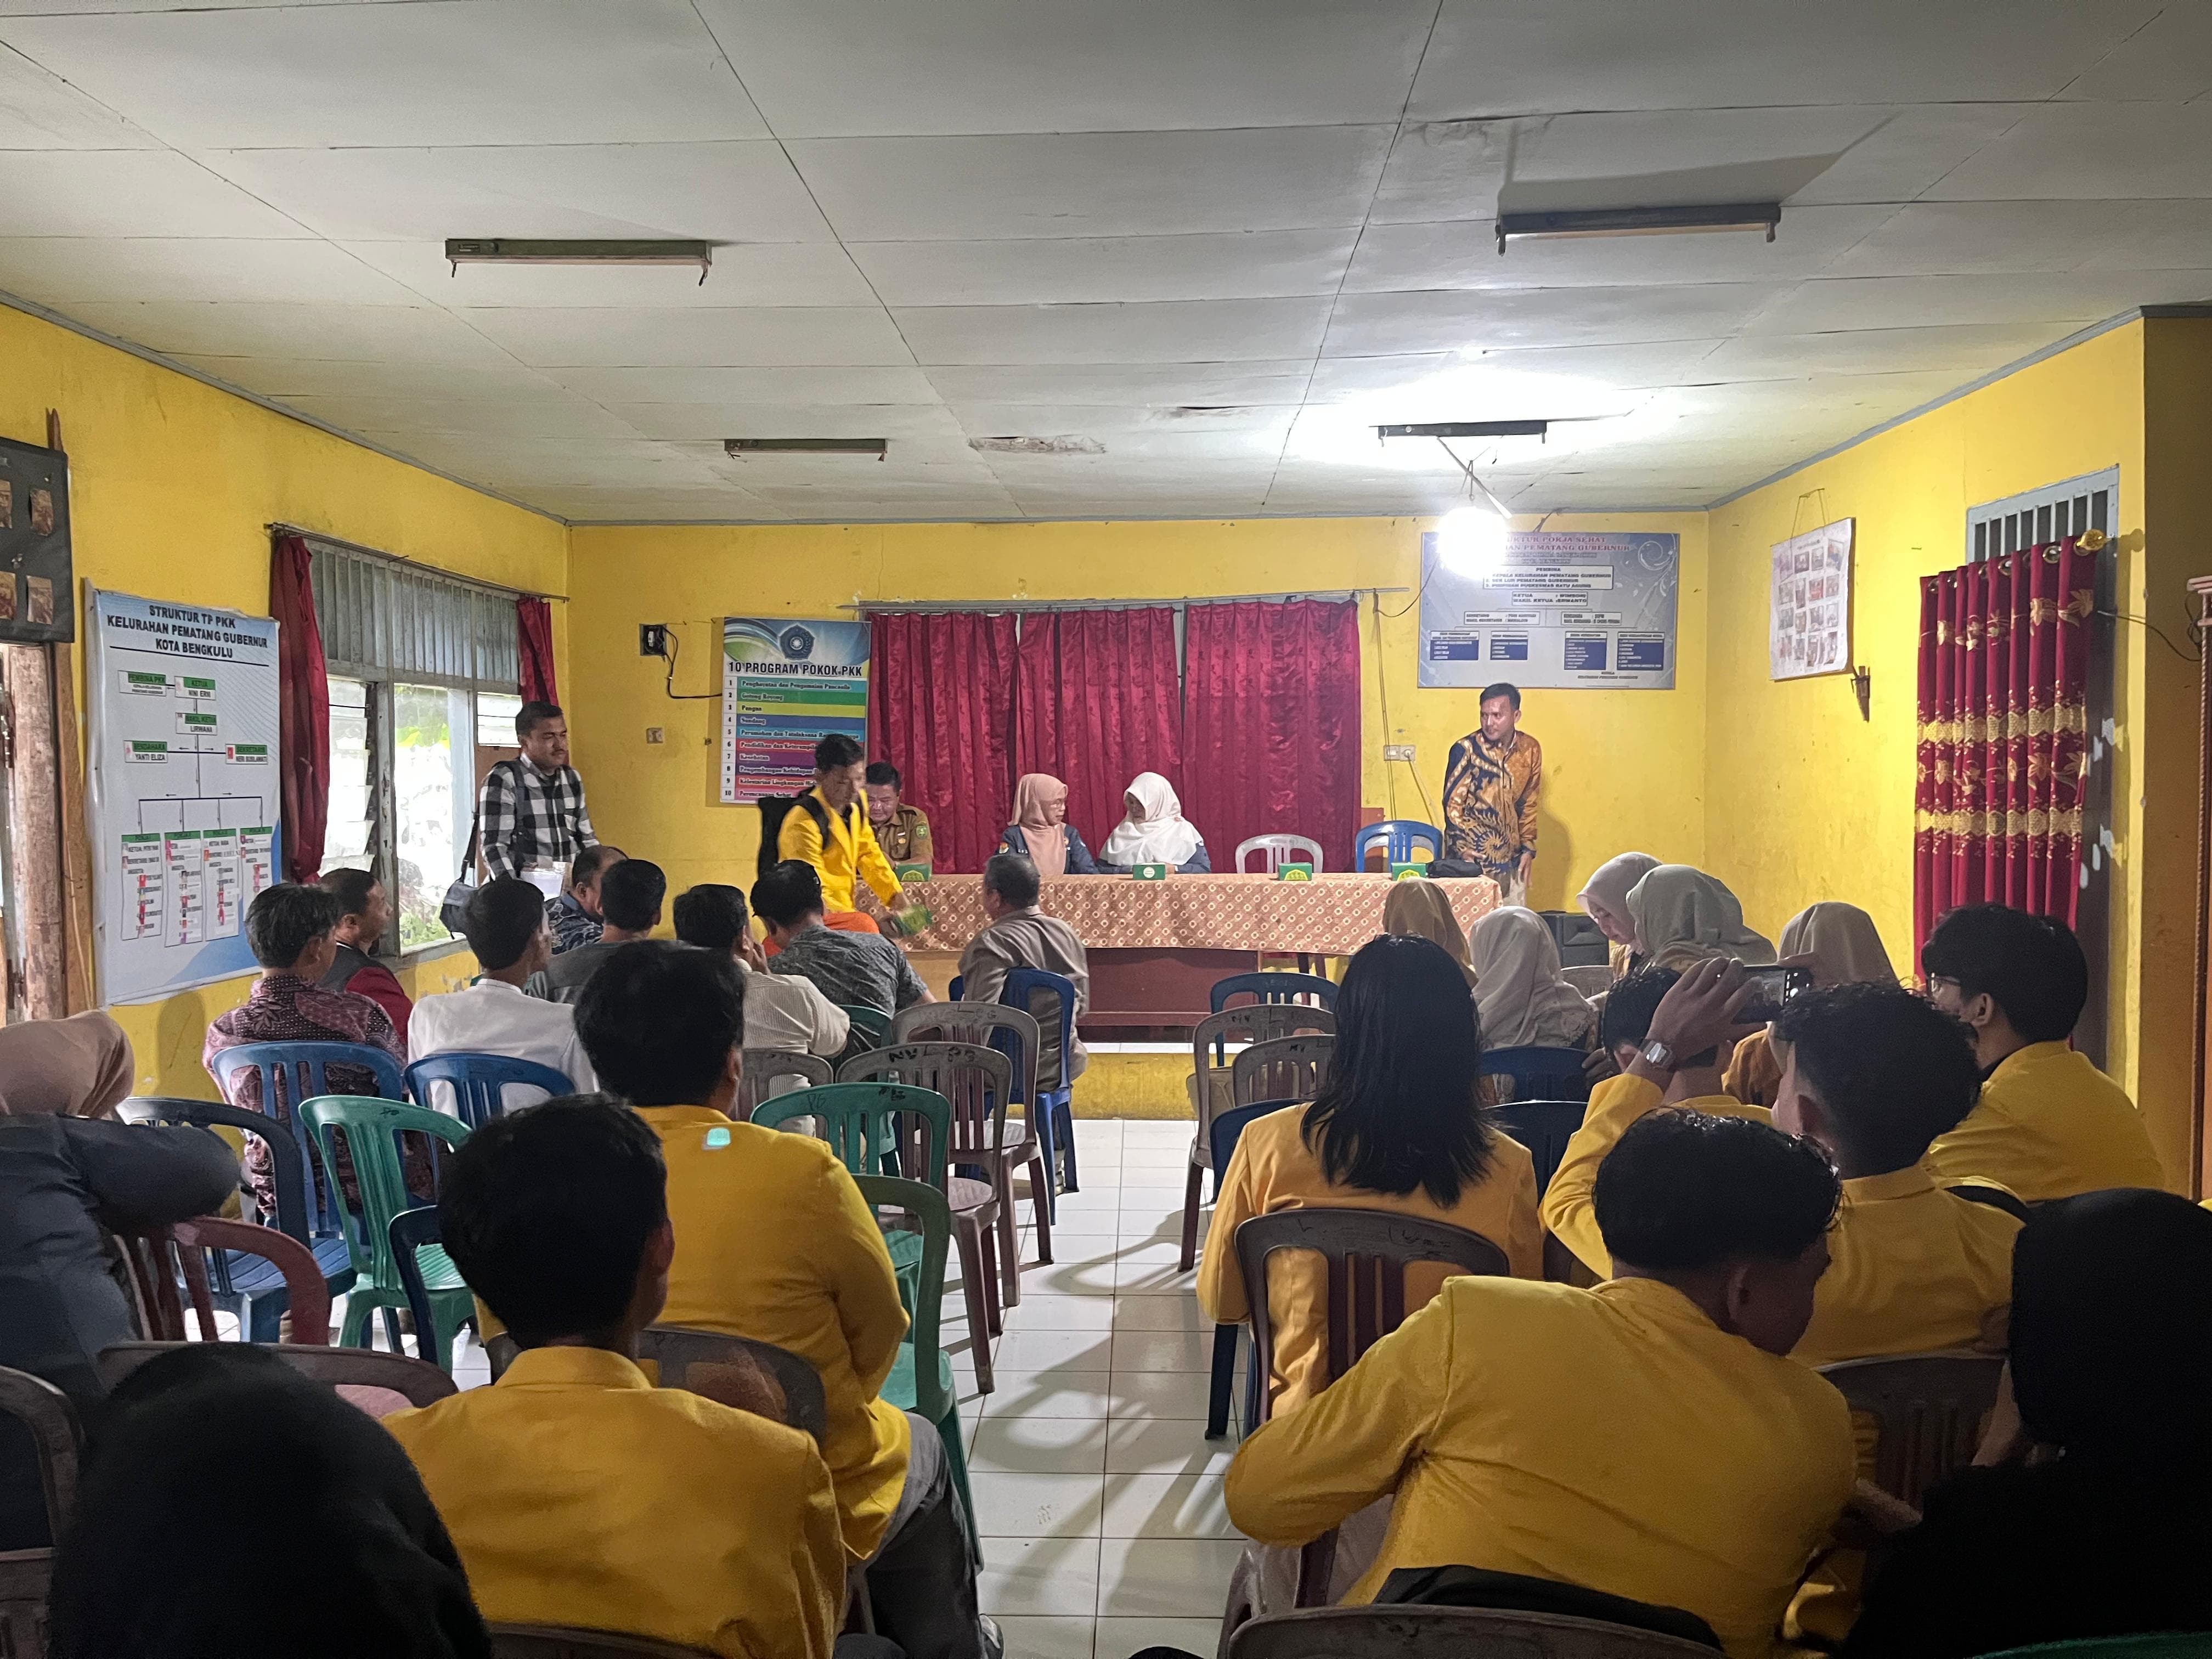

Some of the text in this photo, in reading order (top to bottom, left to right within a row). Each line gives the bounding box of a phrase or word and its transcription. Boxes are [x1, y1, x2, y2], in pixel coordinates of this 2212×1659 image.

[149, 605, 236, 629] STRUKTUR TP PKK
[107, 614, 268, 648] KELURAHAN PEMATANG GUBERNUR
[156, 638, 233, 658] KOTA BENGKULU
[729, 662, 862, 676] 10 PROGRAM POKOK PKK
